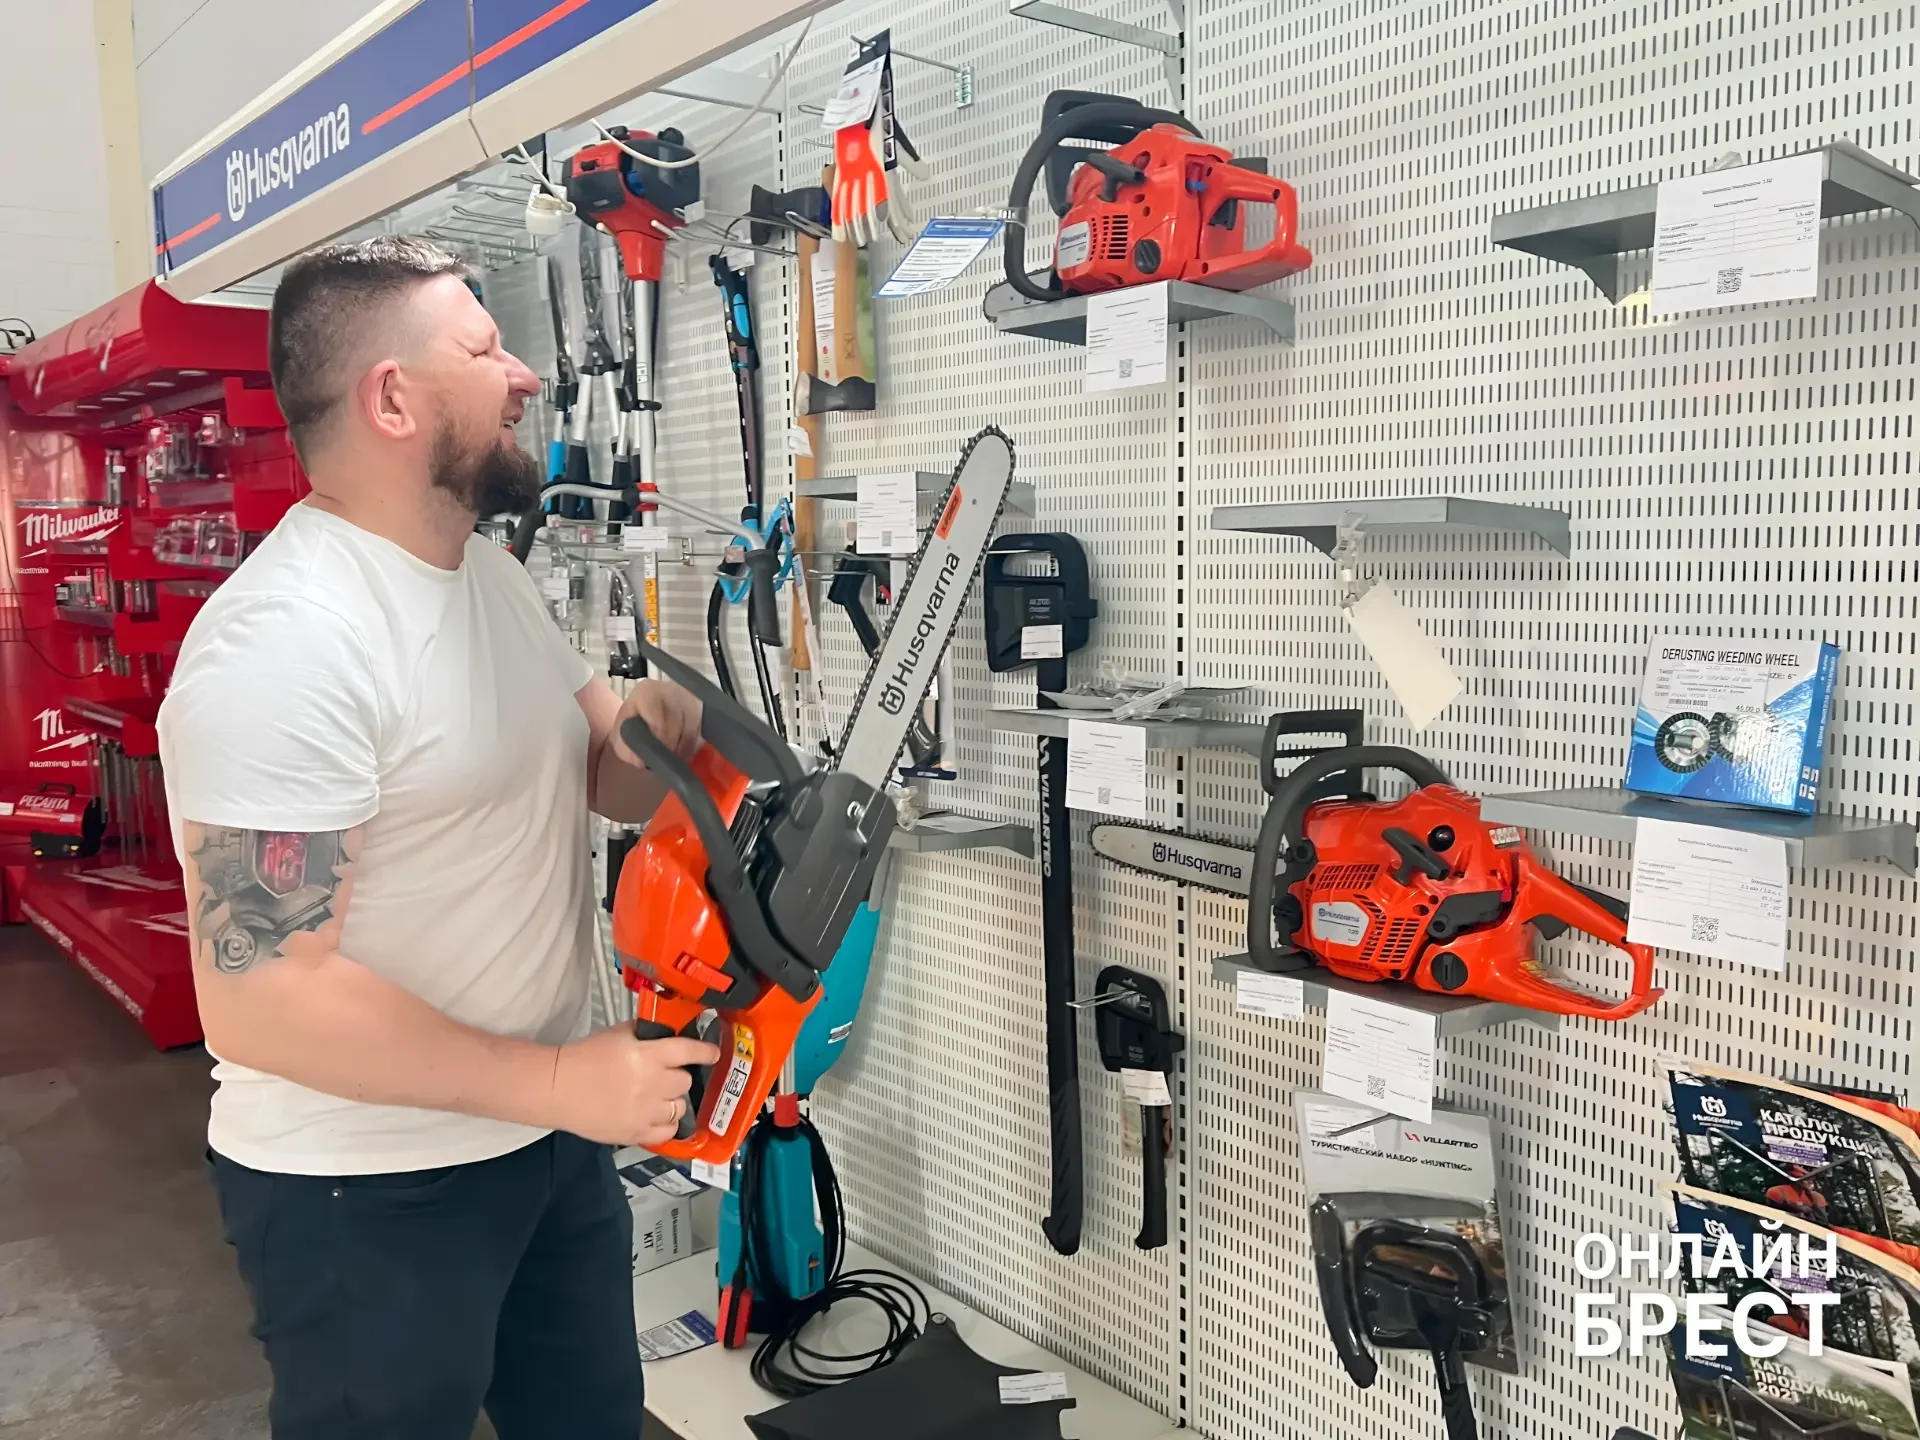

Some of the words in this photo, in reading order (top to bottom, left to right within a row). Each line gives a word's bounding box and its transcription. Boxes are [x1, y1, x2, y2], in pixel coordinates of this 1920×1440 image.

[246, 103, 350, 203] Husqvarna
[892, 551, 961, 688] Husqvarna
[1662, 647, 1715, 662] DERUSTING
[1717, 650, 1762, 665] WEEDING
[1765, 653, 1800, 667] WHEEL
[1167, 846, 1242, 880] Husqvarna
[1760, 1108, 1843, 1135] КАТАЛОГ
[1310, 1139, 1384, 1158] ТУРИСТИЧЕСКИЙ
[1386, 1152, 1418, 1164] НАБОР
[1763, 1121, 1881, 1158] ПРОДУКЦИИ
[643, 1231, 654, 1249] KIT
[1753, 1369, 1868, 1410] ПРОДУКЦИИ
[1756, 1381, 1800, 1403] 2021
